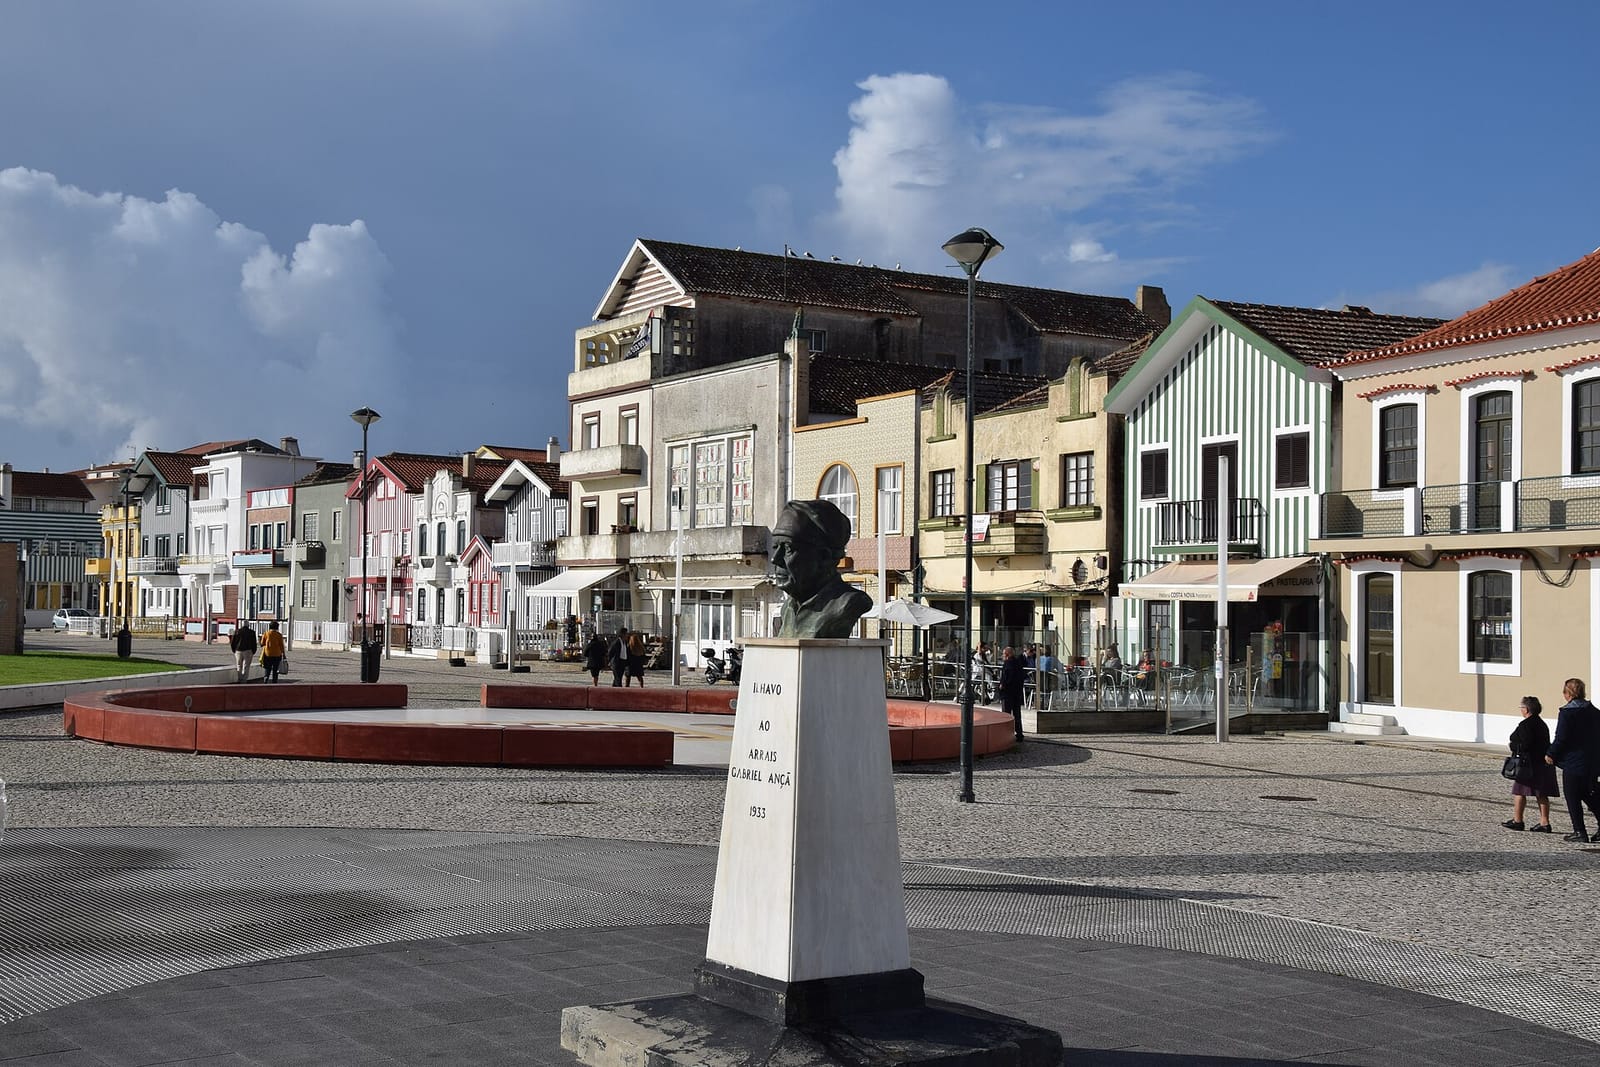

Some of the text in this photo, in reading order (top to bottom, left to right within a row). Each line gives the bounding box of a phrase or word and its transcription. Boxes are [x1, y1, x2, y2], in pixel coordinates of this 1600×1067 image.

[1277, 577, 1314, 586] PASTELARIA
[758, 720, 770, 731] AO
[748, 748, 778, 762] ARRAIS
[731, 766, 791, 789] GABRIEL ANÇÃ
[749, 806, 766, 819] 1933
